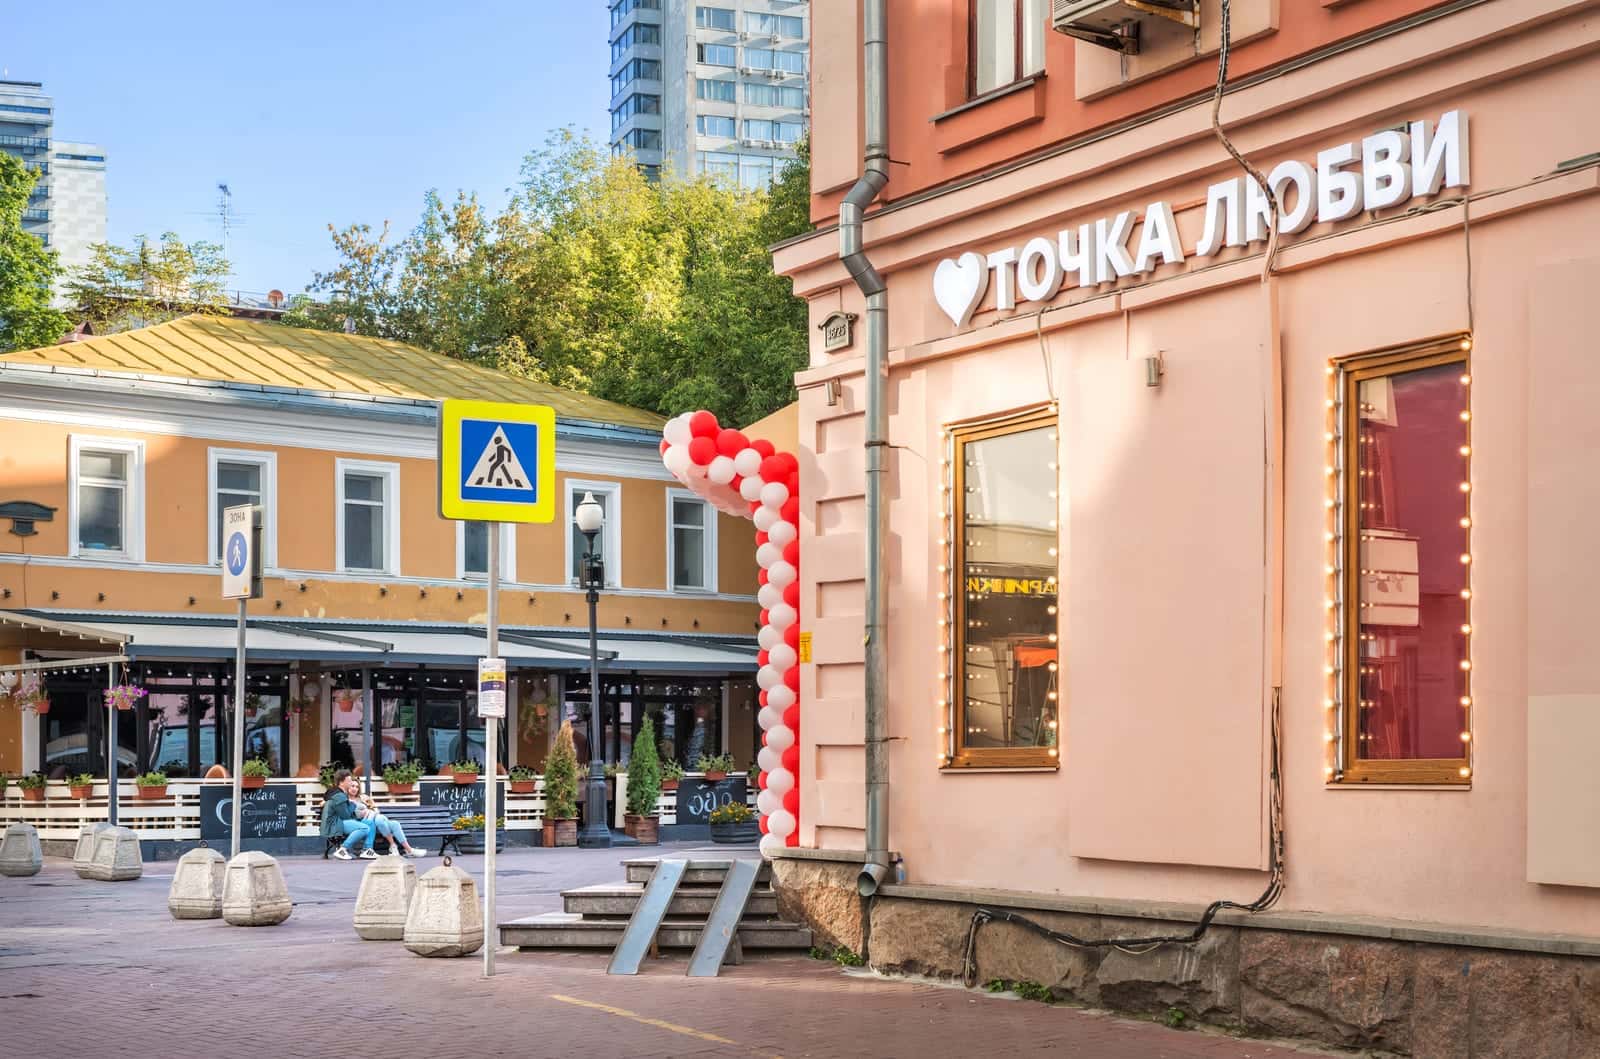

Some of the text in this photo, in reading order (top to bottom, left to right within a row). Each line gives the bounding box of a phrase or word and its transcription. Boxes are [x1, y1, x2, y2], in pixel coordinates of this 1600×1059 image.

[988, 109, 1470, 311] ТОЧКА ЛЮБВИ
[230, 511, 245, 524] ЗОНА
